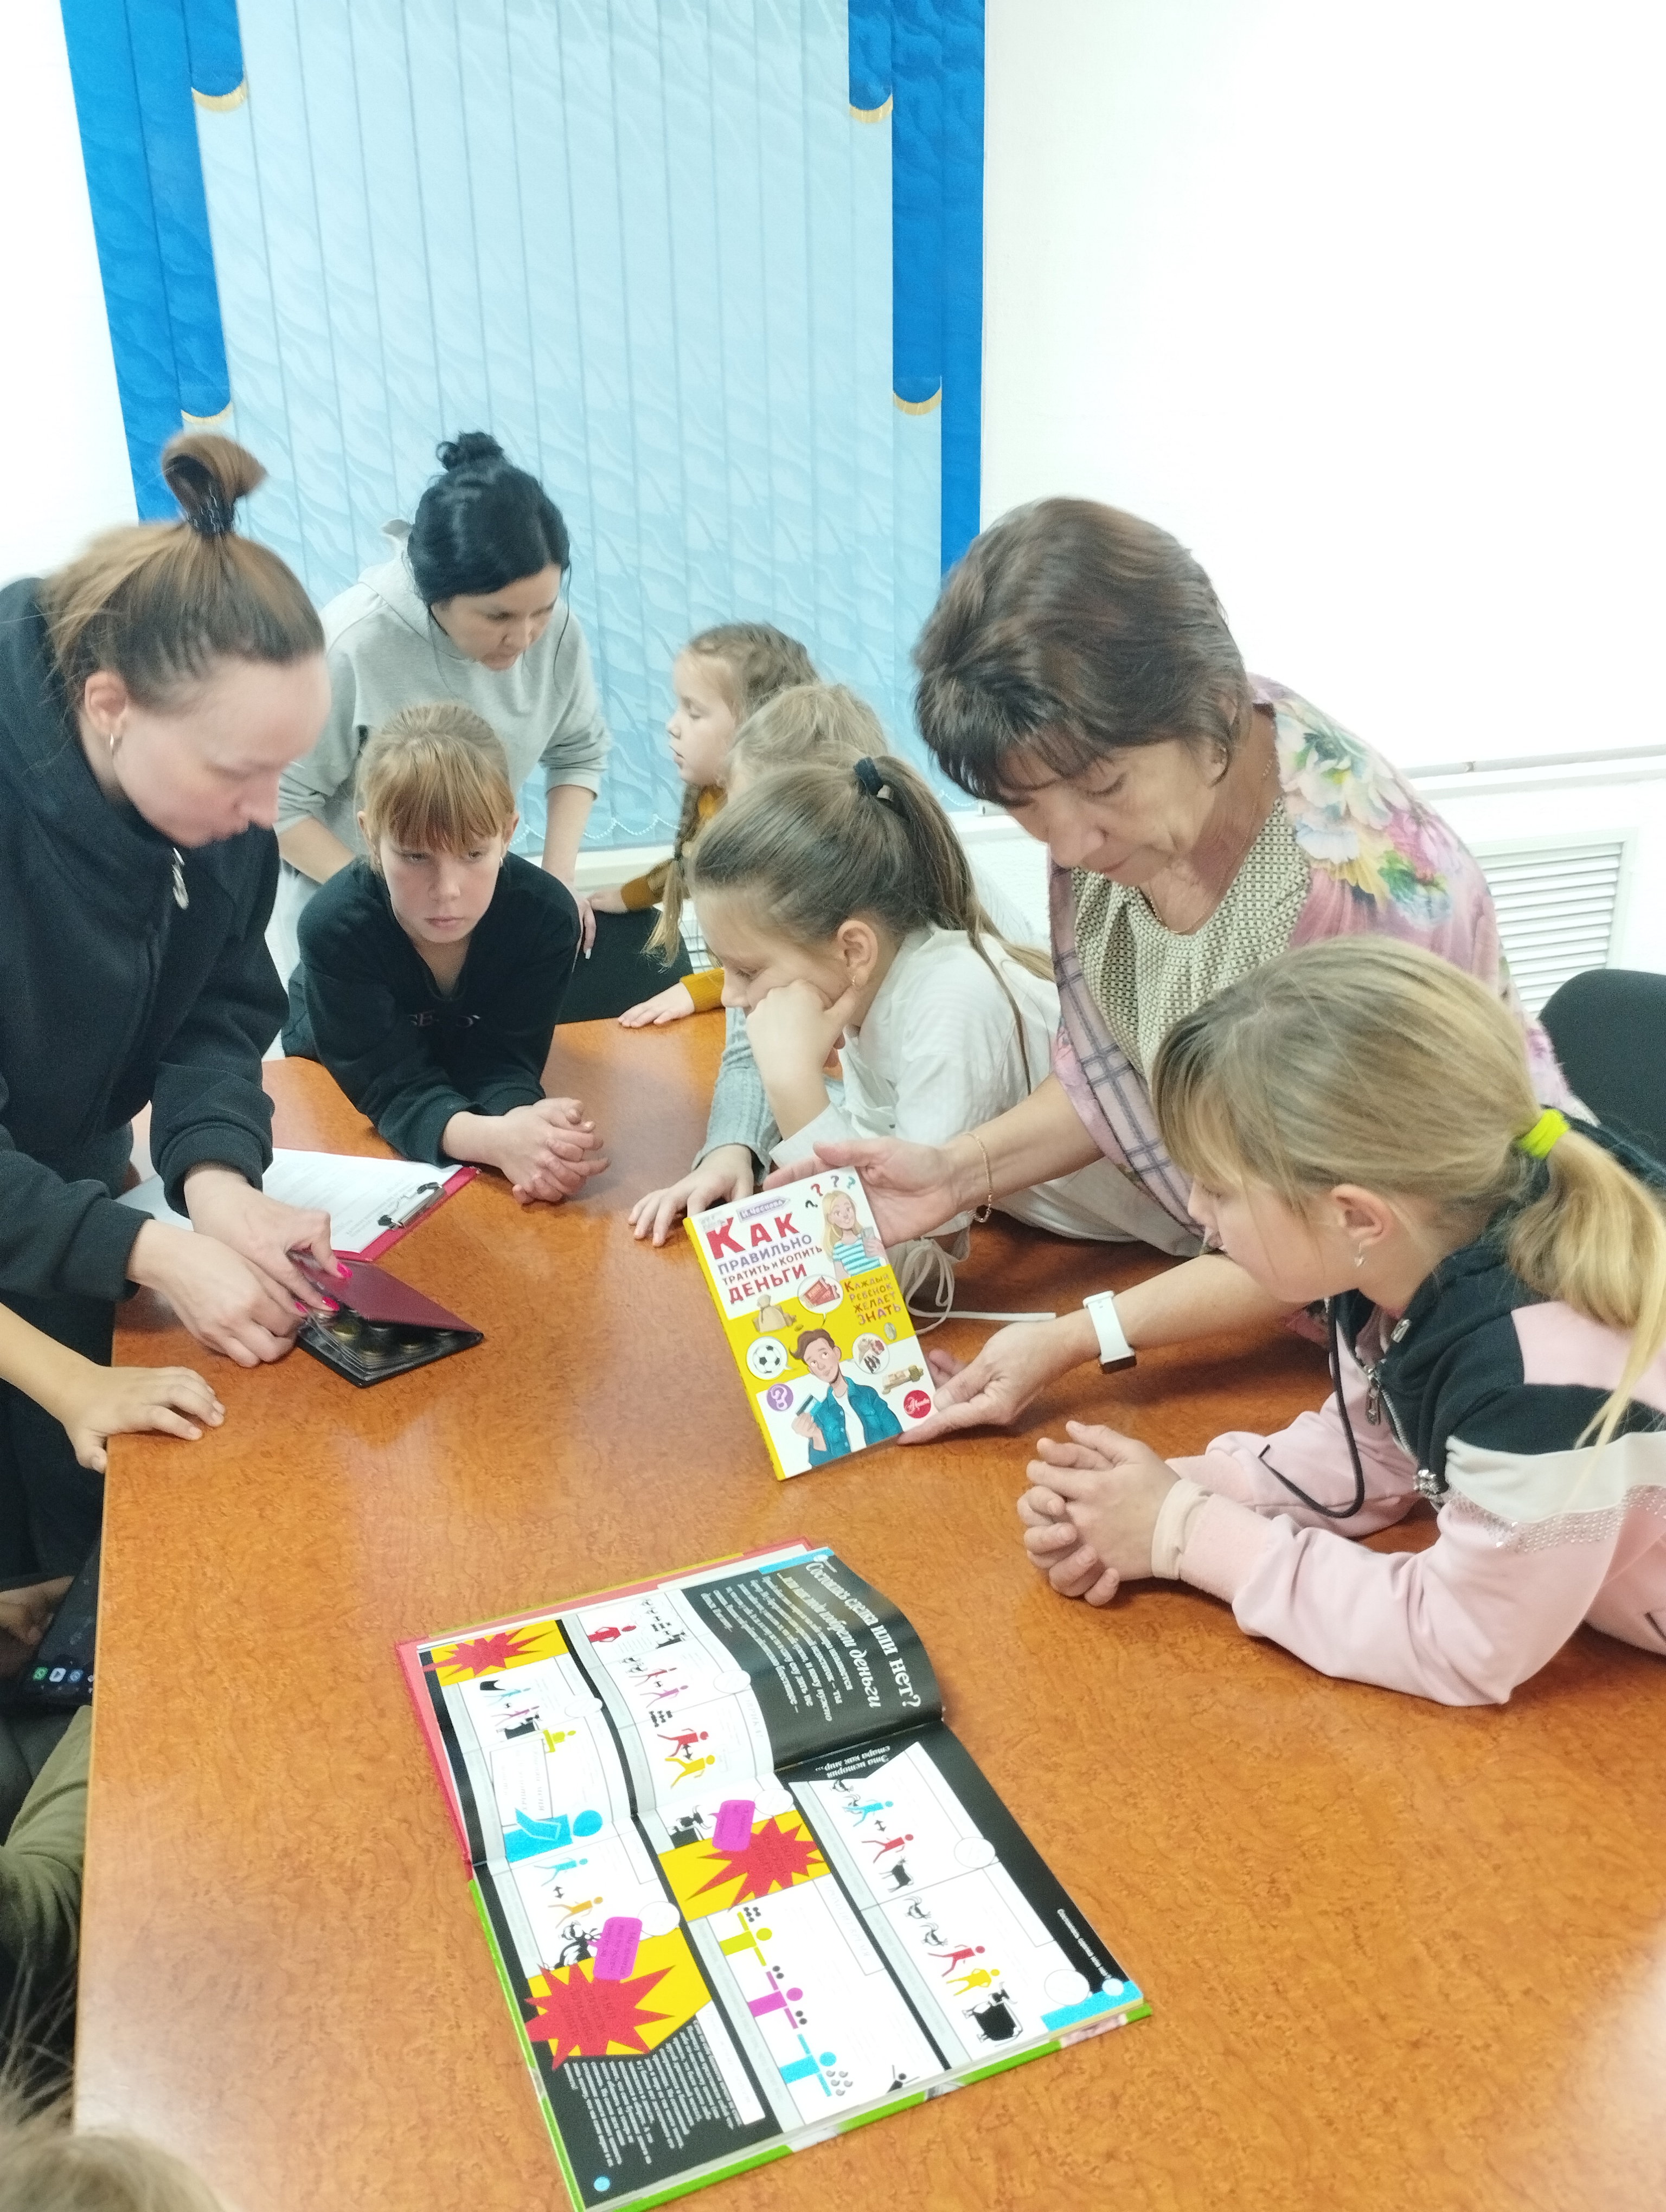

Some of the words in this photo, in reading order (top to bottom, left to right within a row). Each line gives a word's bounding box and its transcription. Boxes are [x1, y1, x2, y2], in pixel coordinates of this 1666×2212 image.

[717, 1234, 812, 1275] ПРАВИЛЬНО
[722, 1263, 770, 1285] ТРАТИТЬ
[779, 1246, 823, 1266] КОПИТЬ
[728, 1263, 807, 1304] ДЕНЬГИ
[853, 1291, 895, 1313] ЖЕЛАЕТ
[857, 1303, 901, 1326] ЗНАТЬ
[844, 1598, 879, 1626] сделка
[870, 1624, 898, 1656] или
[889, 1658, 921, 1708] нет?
[849, 1649, 881, 1708] деньги
[844, 1754, 860, 1765] как
[862, 1746, 890, 1759] стара
[867, 1754, 889, 1765] Эта
[826, 1761, 866, 1778] история
